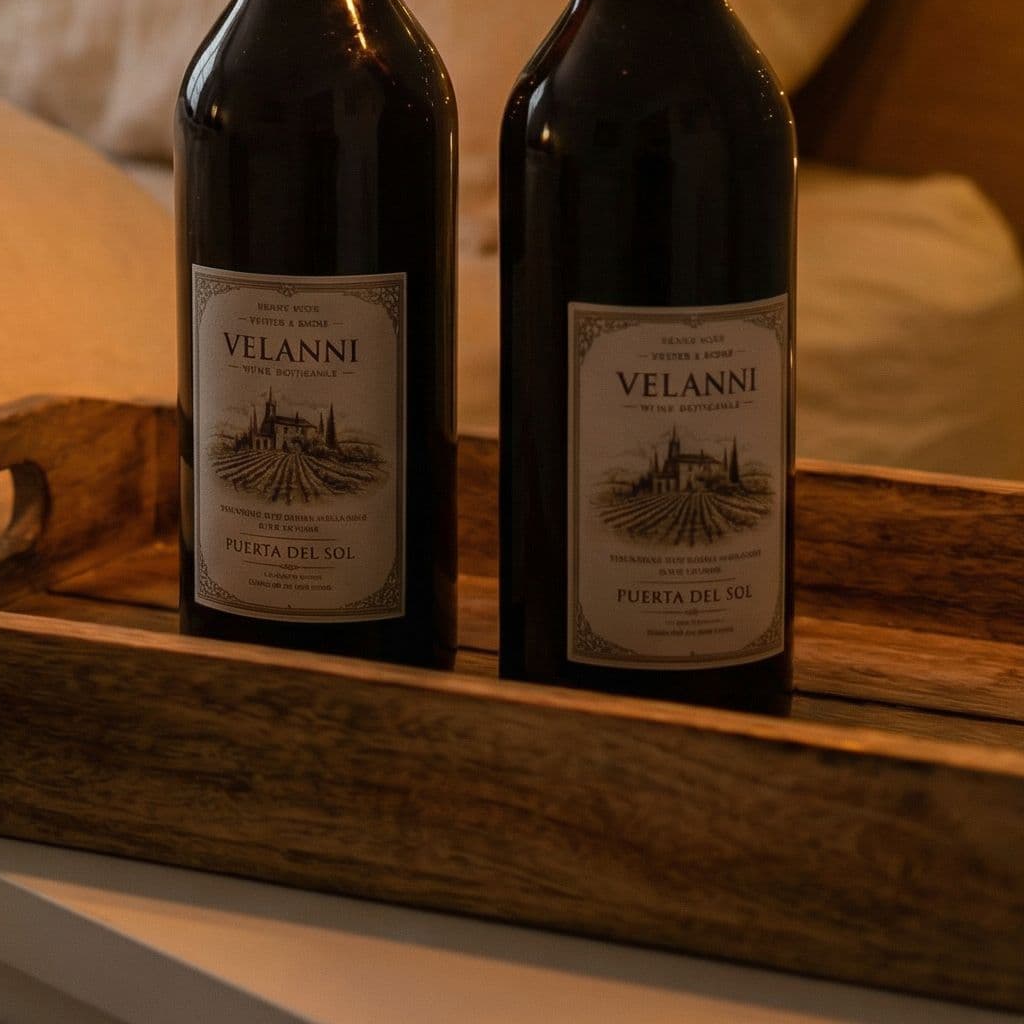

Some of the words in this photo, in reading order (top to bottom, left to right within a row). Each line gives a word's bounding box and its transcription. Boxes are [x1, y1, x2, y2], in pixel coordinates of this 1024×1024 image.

[224, 331, 360, 363] VELANNI
[616, 367, 758, 398] VELANNI
[226, 537, 282, 558] PUERTA
[287, 546, 320, 560] DEL
[324, 546, 355, 560] SOL
[617, 588, 685, 604] PUERTA
[690, 588, 721, 604] DEL
[726, 584, 753, 601] SOL
